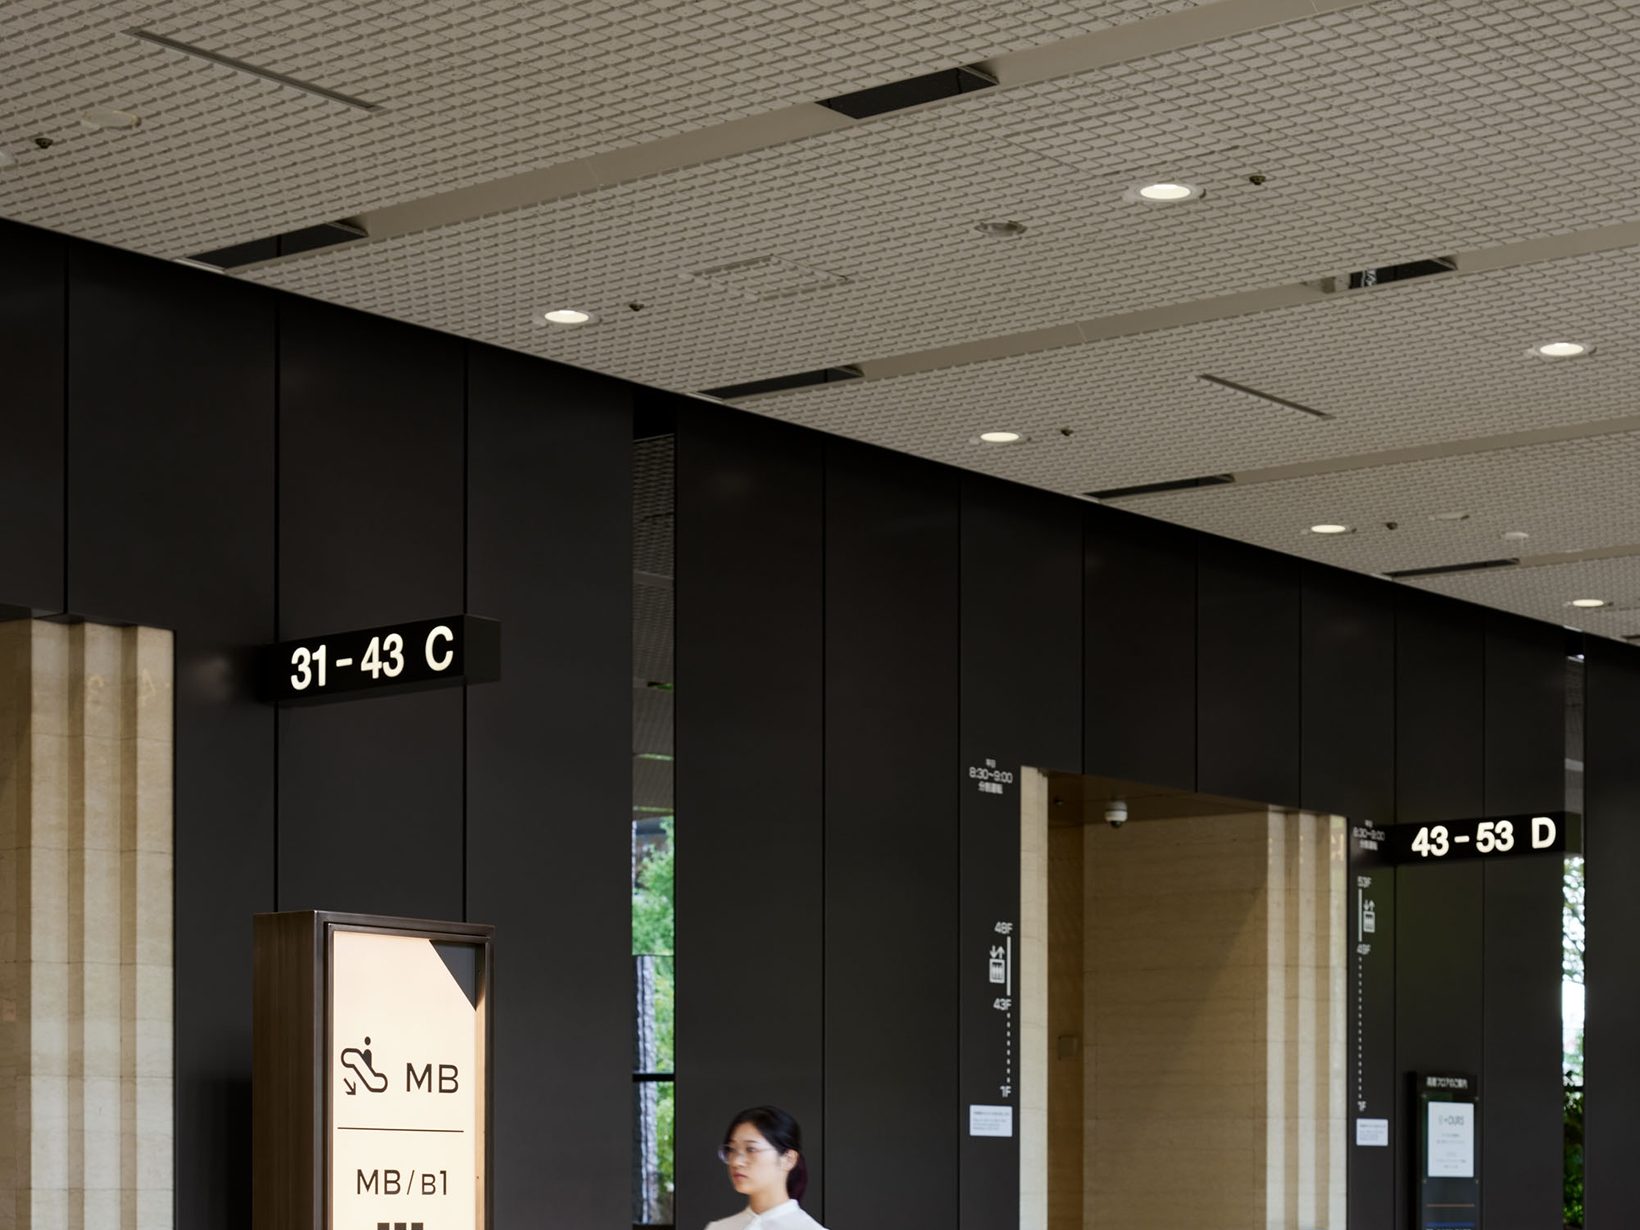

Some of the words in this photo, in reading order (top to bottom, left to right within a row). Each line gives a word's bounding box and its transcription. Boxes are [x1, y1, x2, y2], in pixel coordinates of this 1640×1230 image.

[425, 625, 454, 672] C
[1531, 816, 1556, 849] D
[994, 921, 1013, 935] 48F
[993, 998, 1012, 1012] 43F
[406, 1063, 459, 1093] MB
[1000, 1085, 1012, 1098] 1F
